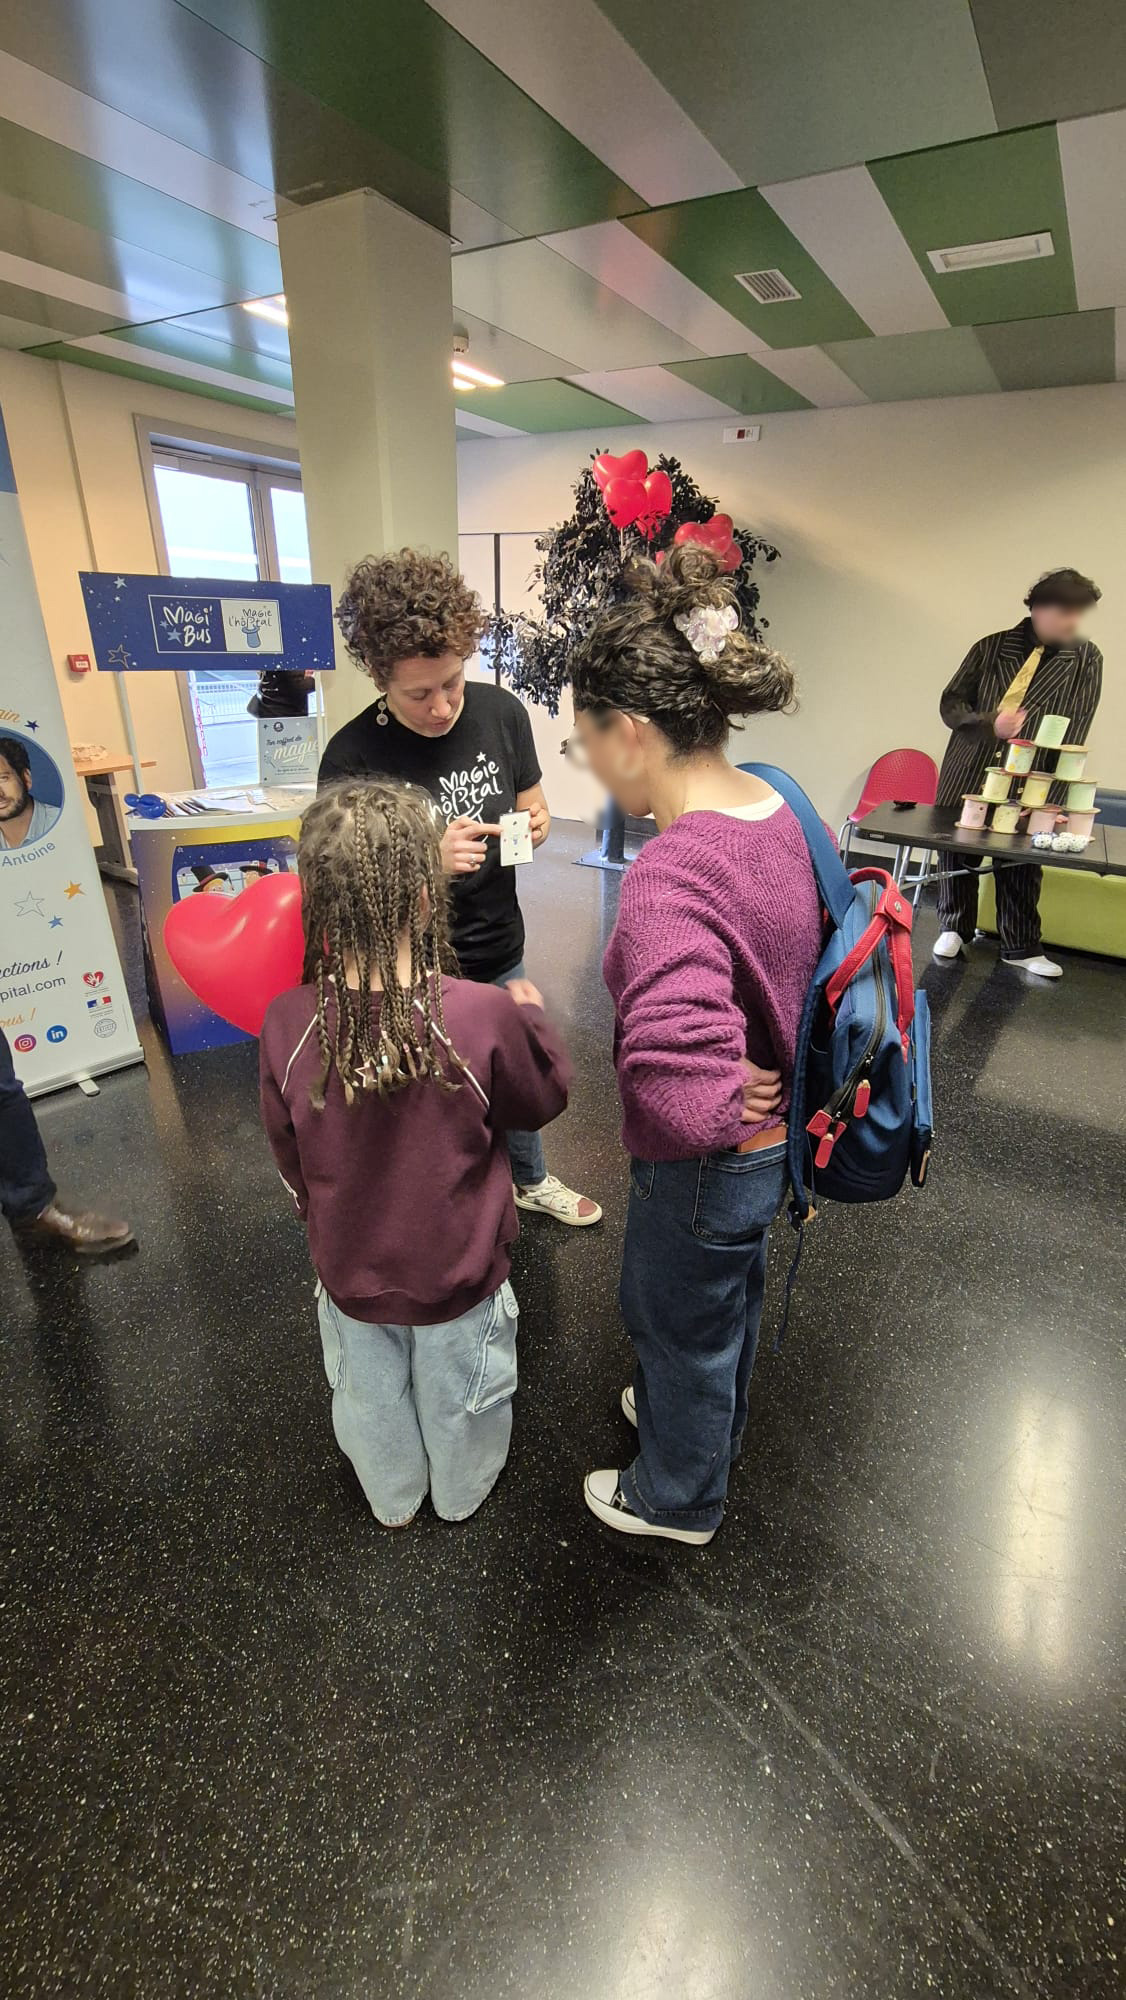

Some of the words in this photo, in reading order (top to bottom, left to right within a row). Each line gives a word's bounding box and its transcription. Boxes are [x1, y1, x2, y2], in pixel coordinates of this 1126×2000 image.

[184, 625, 212, 647] Bus
[1, 841, 56, 868] Antoine
[0, 958, 51, 979] ctions
[56, 950, 63, 966] !
